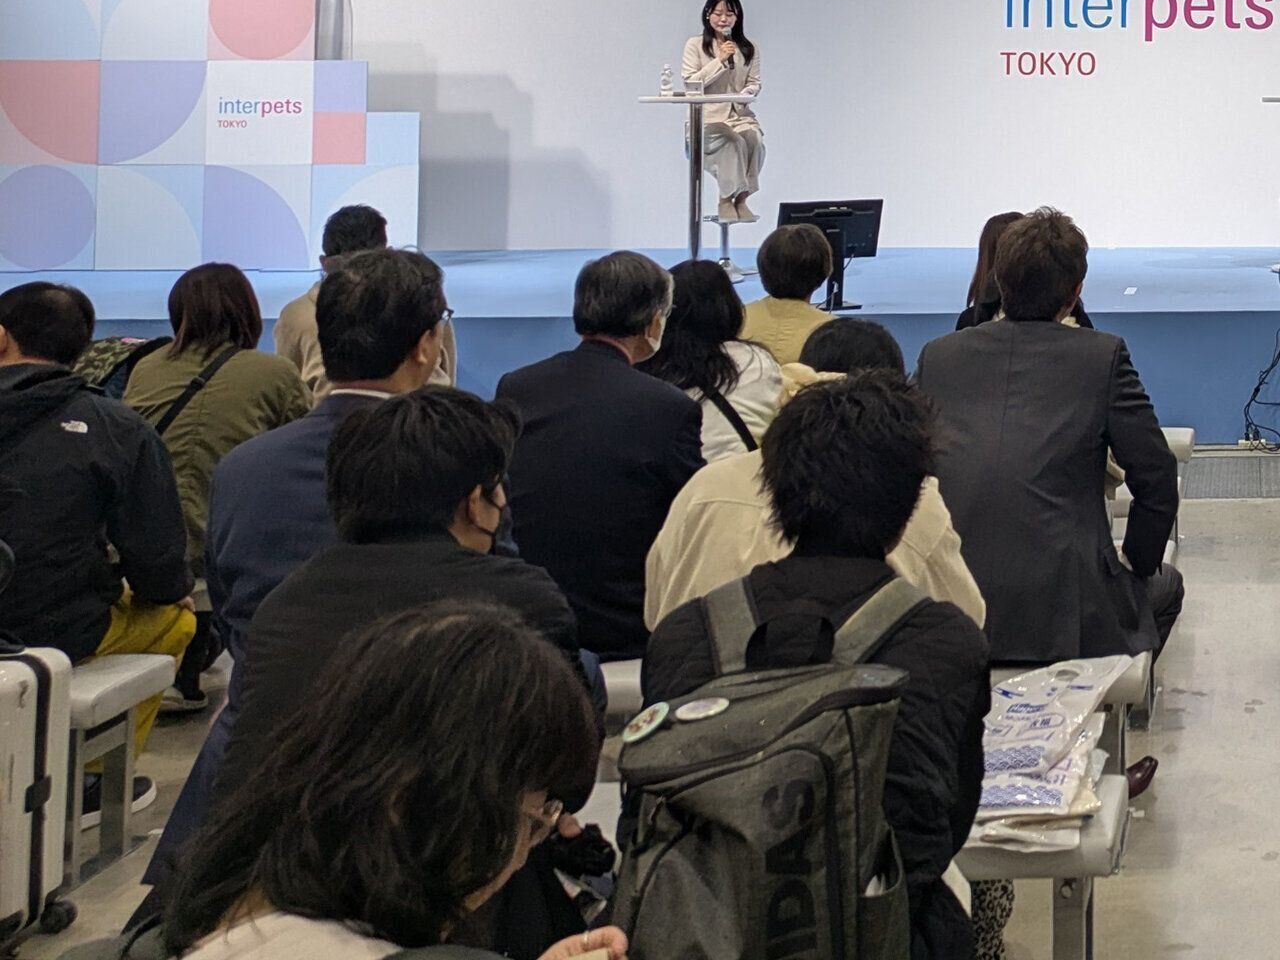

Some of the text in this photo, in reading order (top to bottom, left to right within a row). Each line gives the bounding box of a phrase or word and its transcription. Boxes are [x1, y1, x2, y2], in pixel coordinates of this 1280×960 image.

[1000, 52, 1097, 76] TOKYO
[218, 96, 303, 118] interpets
[217, 119, 248, 129] TOKYO
